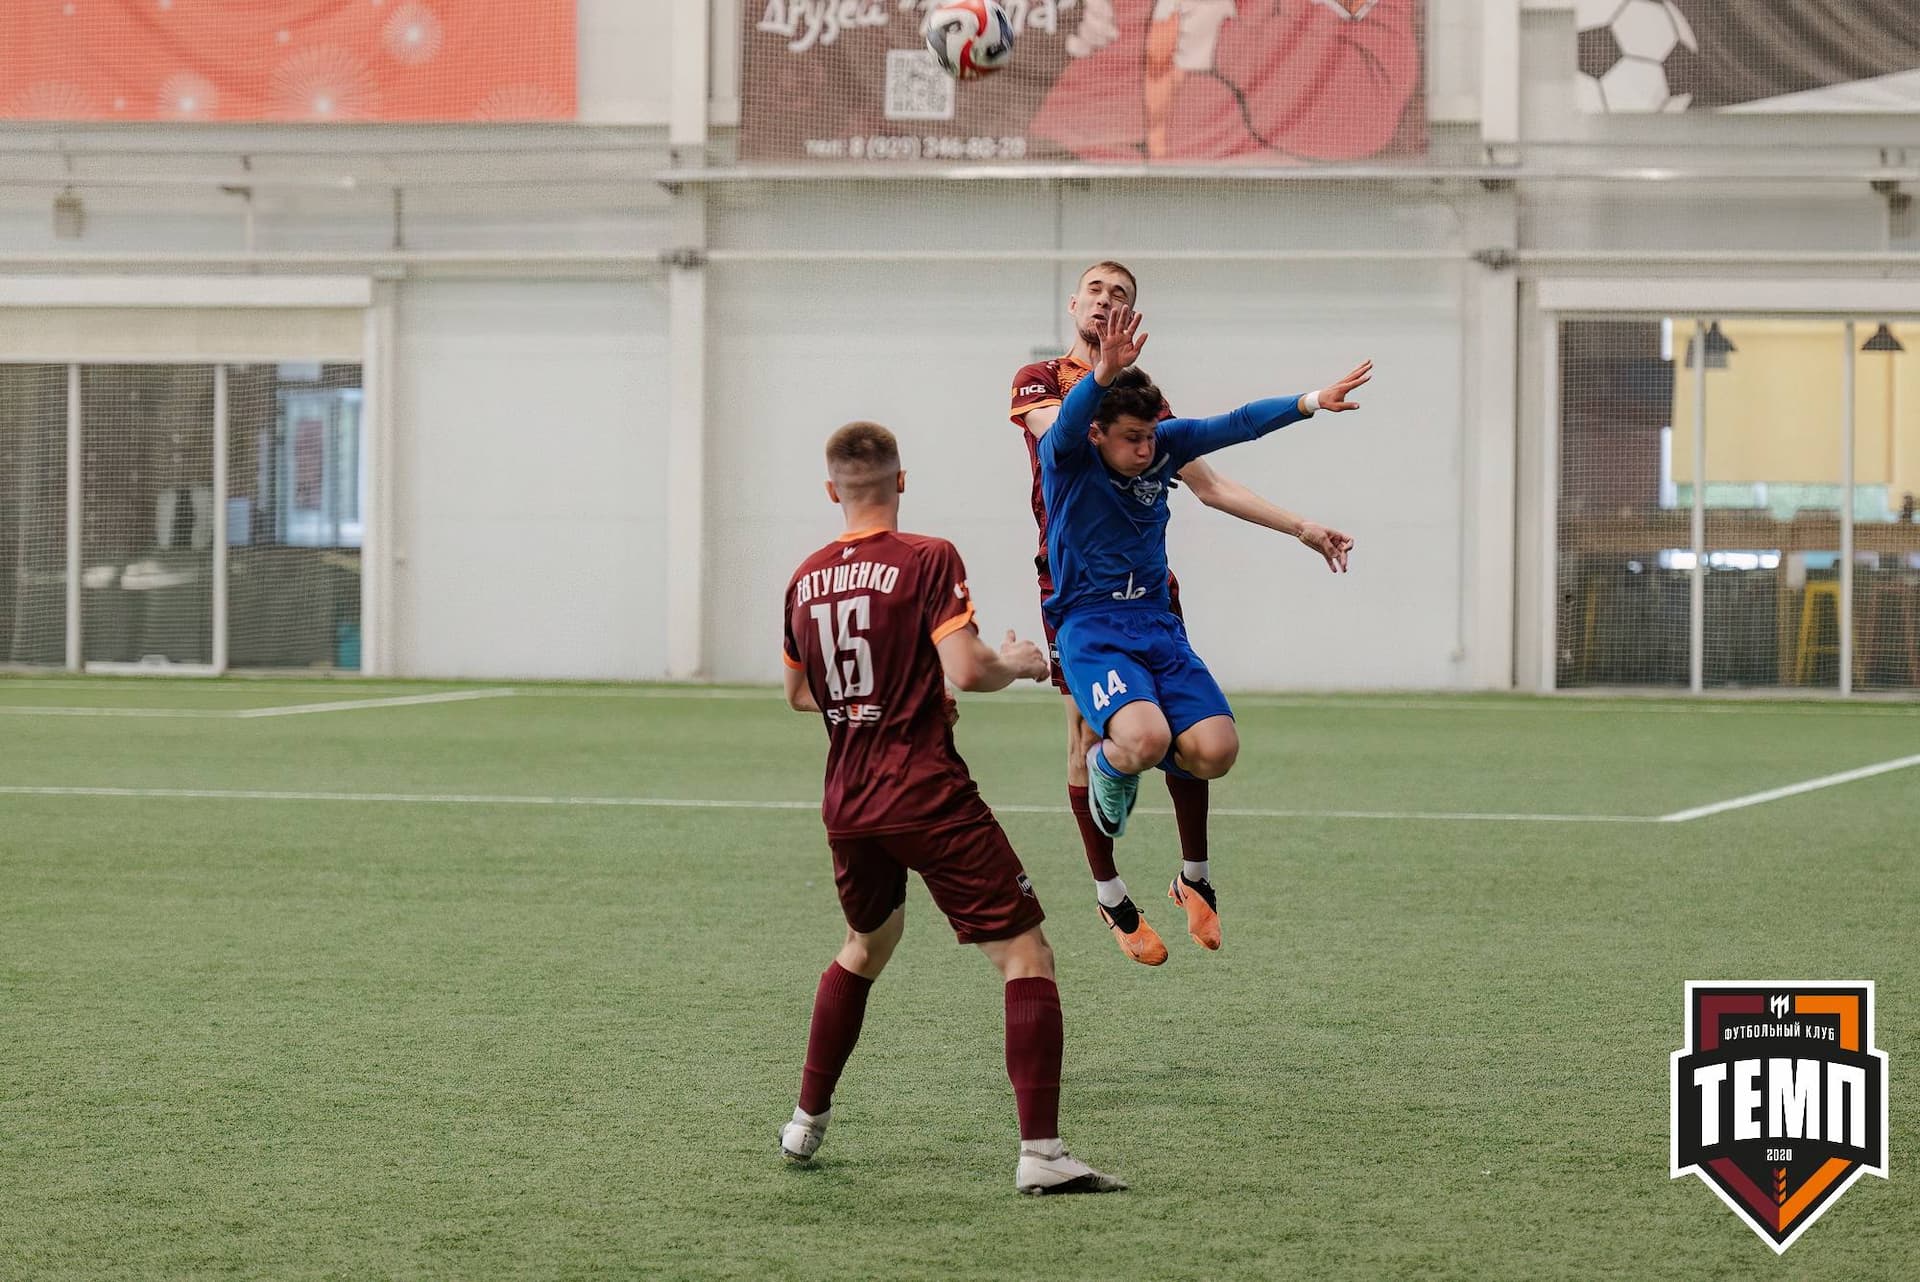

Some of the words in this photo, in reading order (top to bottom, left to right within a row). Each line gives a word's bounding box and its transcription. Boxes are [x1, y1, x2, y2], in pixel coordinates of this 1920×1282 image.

[797, 562, 899, 607] ЕВТУШЕНКО
[810, 595, 874, 701] 15
[1092, 670, 1127, 711] 44
